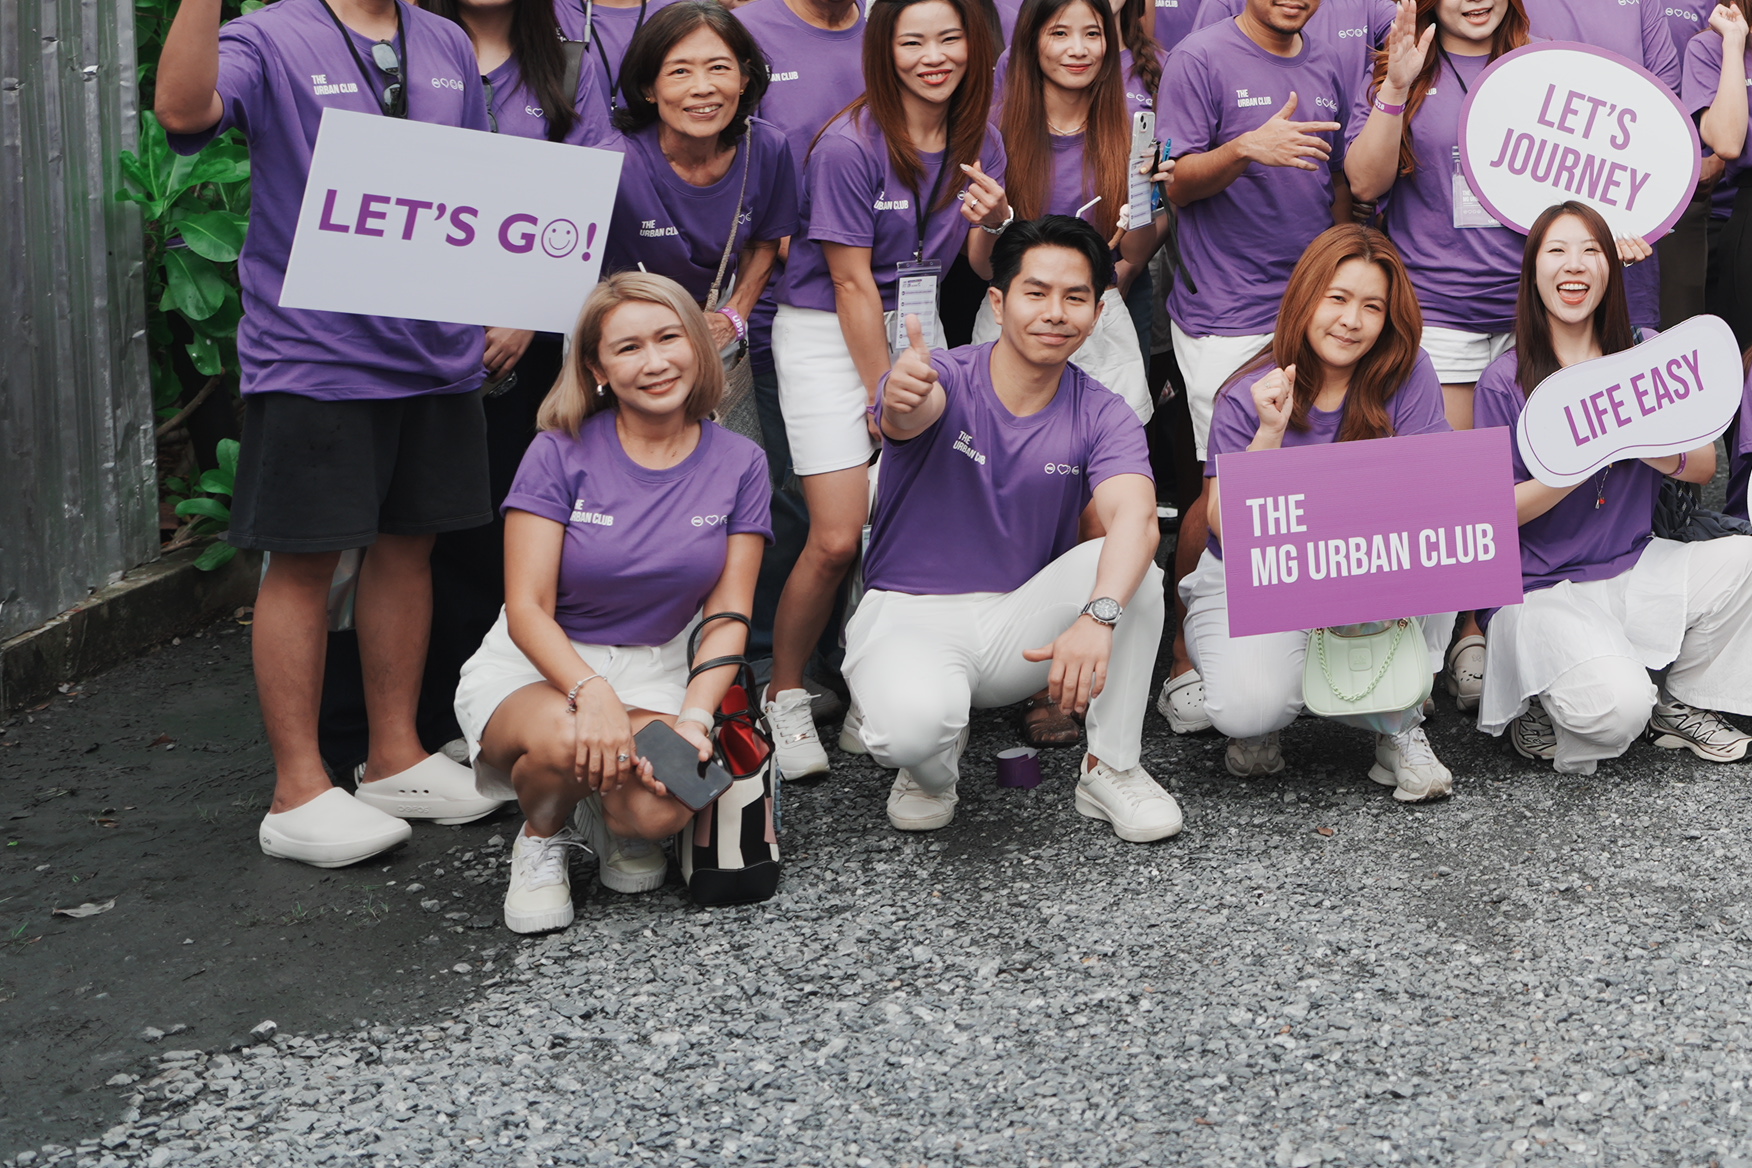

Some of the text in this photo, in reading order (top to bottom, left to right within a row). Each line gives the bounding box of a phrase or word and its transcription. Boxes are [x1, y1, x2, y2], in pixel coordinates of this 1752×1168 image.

[311, 74, 327, 85] THE
[781, 70, 799, 81] CLUB
[313, 82, 359, 96] URBAN CLUB
[1236, 89, 1249, 98] THE
[1237, 96, 1272, 108] URBAN CLUB
[1536, 83, 1638, 151] LET'S
[1489, 127, 1652, 212] JOURNEY
[893, 199, 909, 210] CLUB
[318, 188, 479, 247] LET'S
[641, 219, 656, 229] THE
[640, 227, 665, 238] URBAN
[1563, 349, 1704, 447] LIFE EASY
[957, 431, 972, 445] THE
[952, 440, 976, 459] URBAN
[592, 513, 614, 526] CLUB
[1245, 493, 1307, 537] THE
[1250, 522, 1496, 587] MG URBAN CLUB
